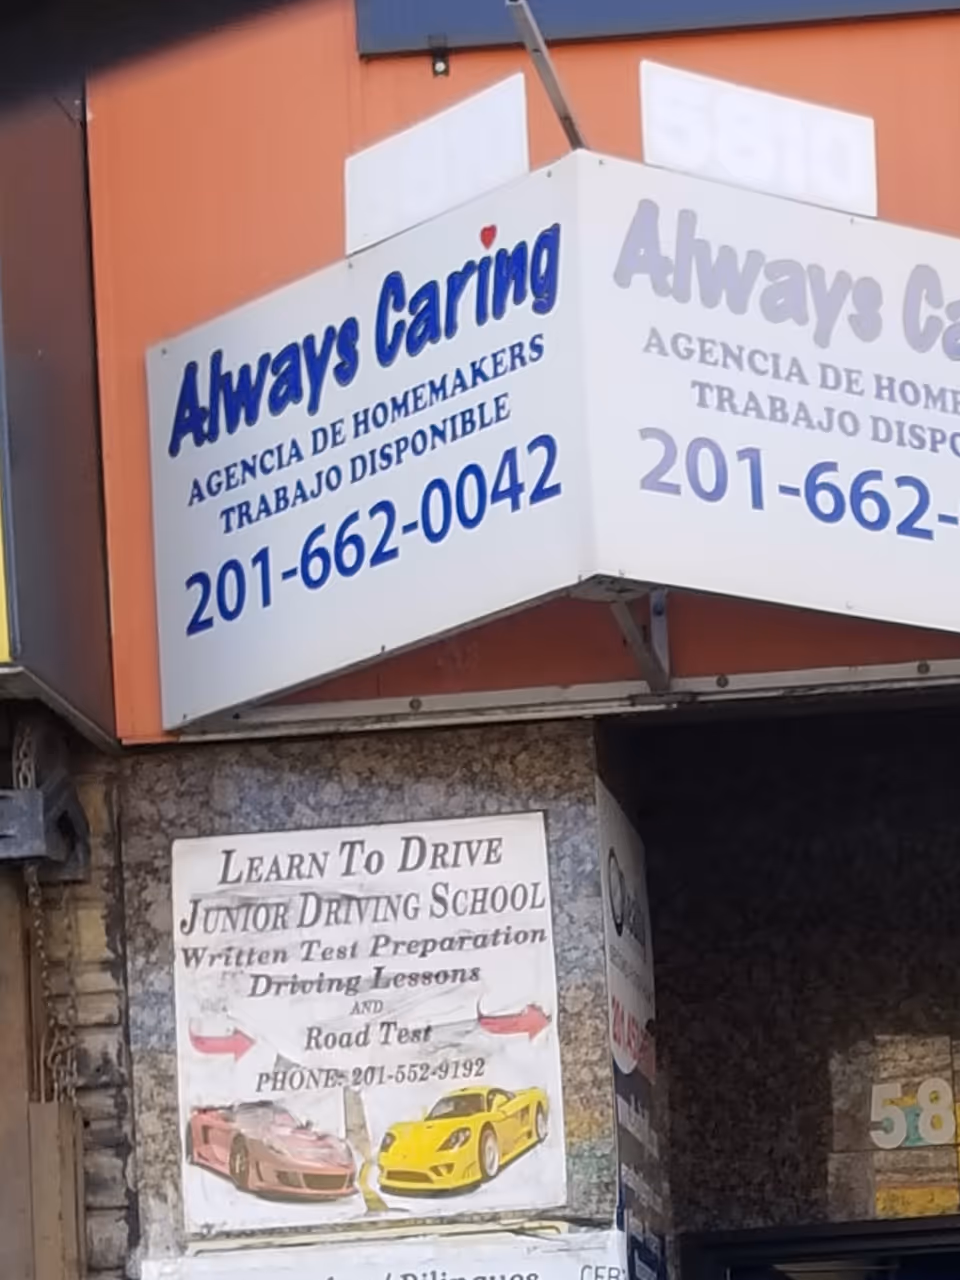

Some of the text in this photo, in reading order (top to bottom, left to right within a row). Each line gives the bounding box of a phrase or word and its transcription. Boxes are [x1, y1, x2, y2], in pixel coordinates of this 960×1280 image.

[612, 197, 883, 349] Always
[168, 222, 562, 458] Always Caring
[642, 327, 809, 386] AGENCIA
[818, 363, 865, 397] DE
[187, 333, 545, 507] AGENCIA DE HOMEMAKERS
[690, 379, 861, 438] TRABAJO
[220, 391, 511, 535] TRABAJO DISPONIBLE
[185, 433, 562, 637] 201-662-0042
[218, 835, 503, 885] LEARN To DRIVE
[179, 882, 546, 936] JUNIOR DRIVING SCHOOL
[180, 926, 548, 970] Written Test Preparation
[248, 966, 481, 998] Driving Lessons
[350, 1000, 384, 1016] AND
[304, 1021, 433, 1051] Road Test
[351, 1057, 486, 1087] 201-552-9192
